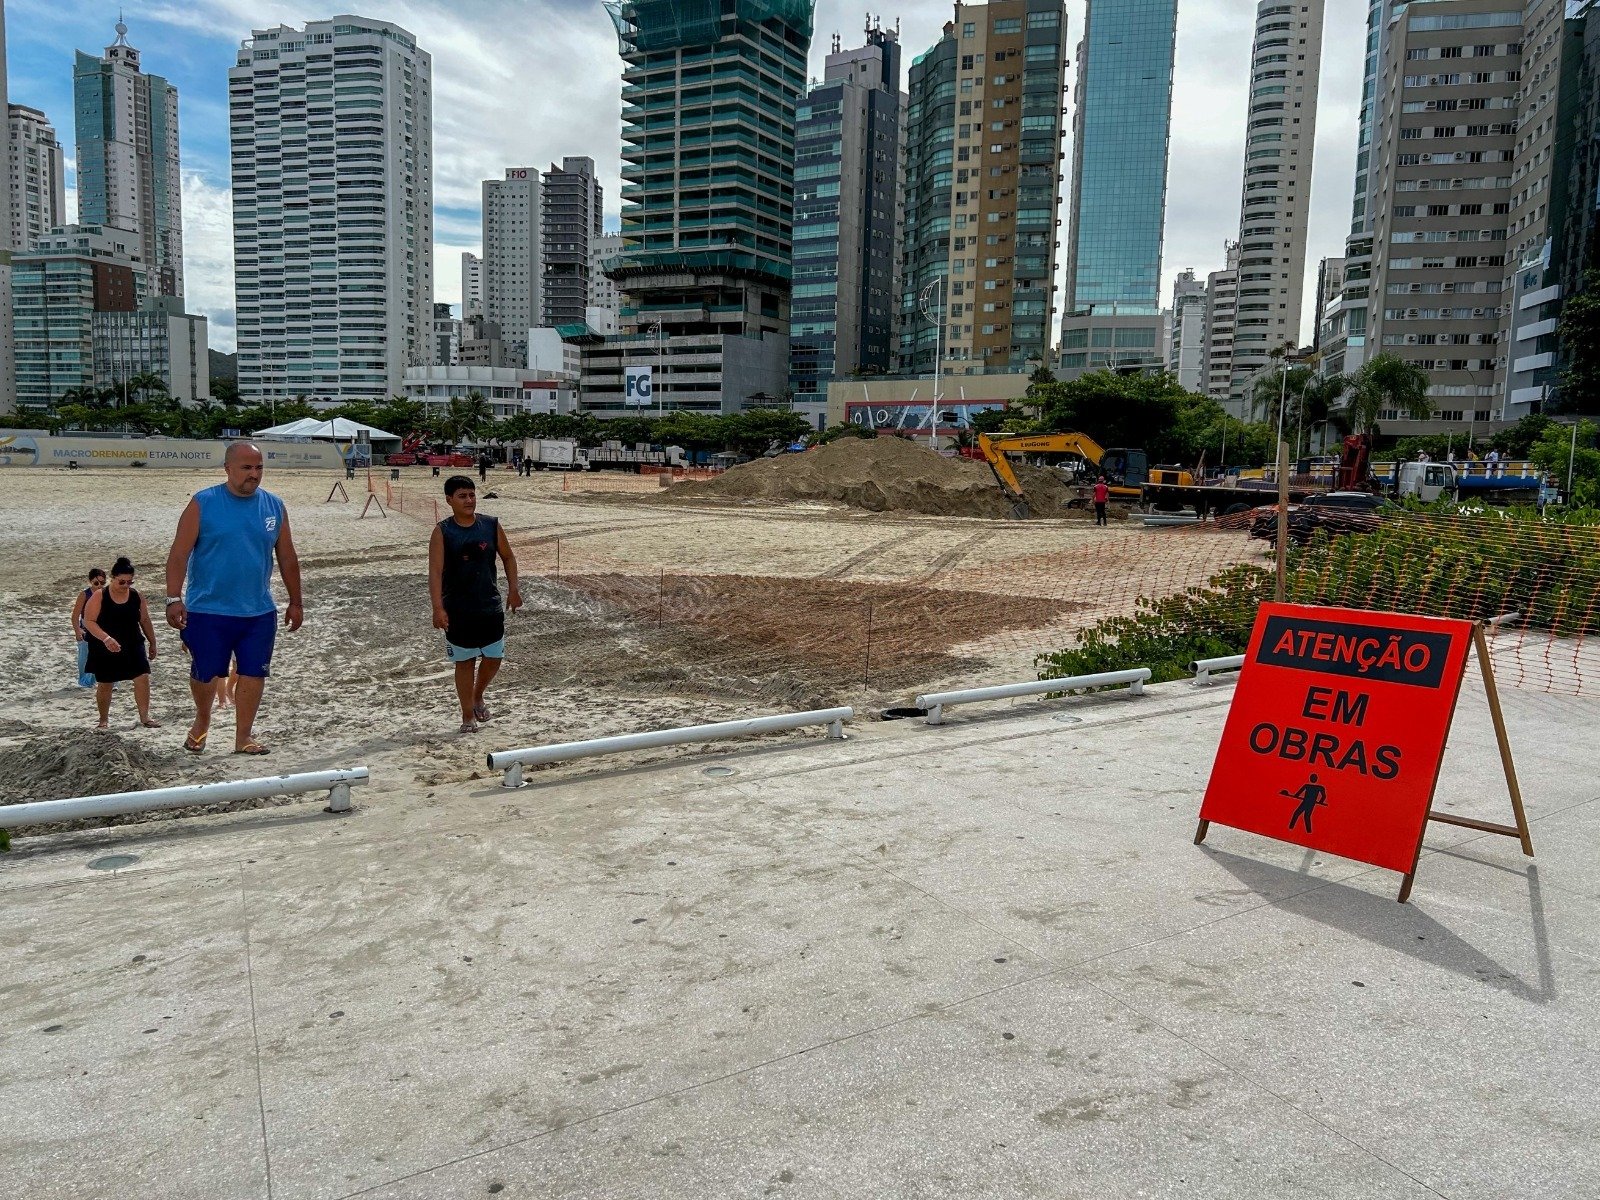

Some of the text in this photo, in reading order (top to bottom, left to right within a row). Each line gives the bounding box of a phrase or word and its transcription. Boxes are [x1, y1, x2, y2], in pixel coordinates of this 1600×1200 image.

[627, 374, 651, 397] FG
[53, 449, 211, 460] MACRODRENAGEM ETAPA NORTE
[1272, 629, 1431, 673] ATENÇÃO
[1302, 686, 1370, 727] EM
[1249, 722, 1402, 780] OBRAS
